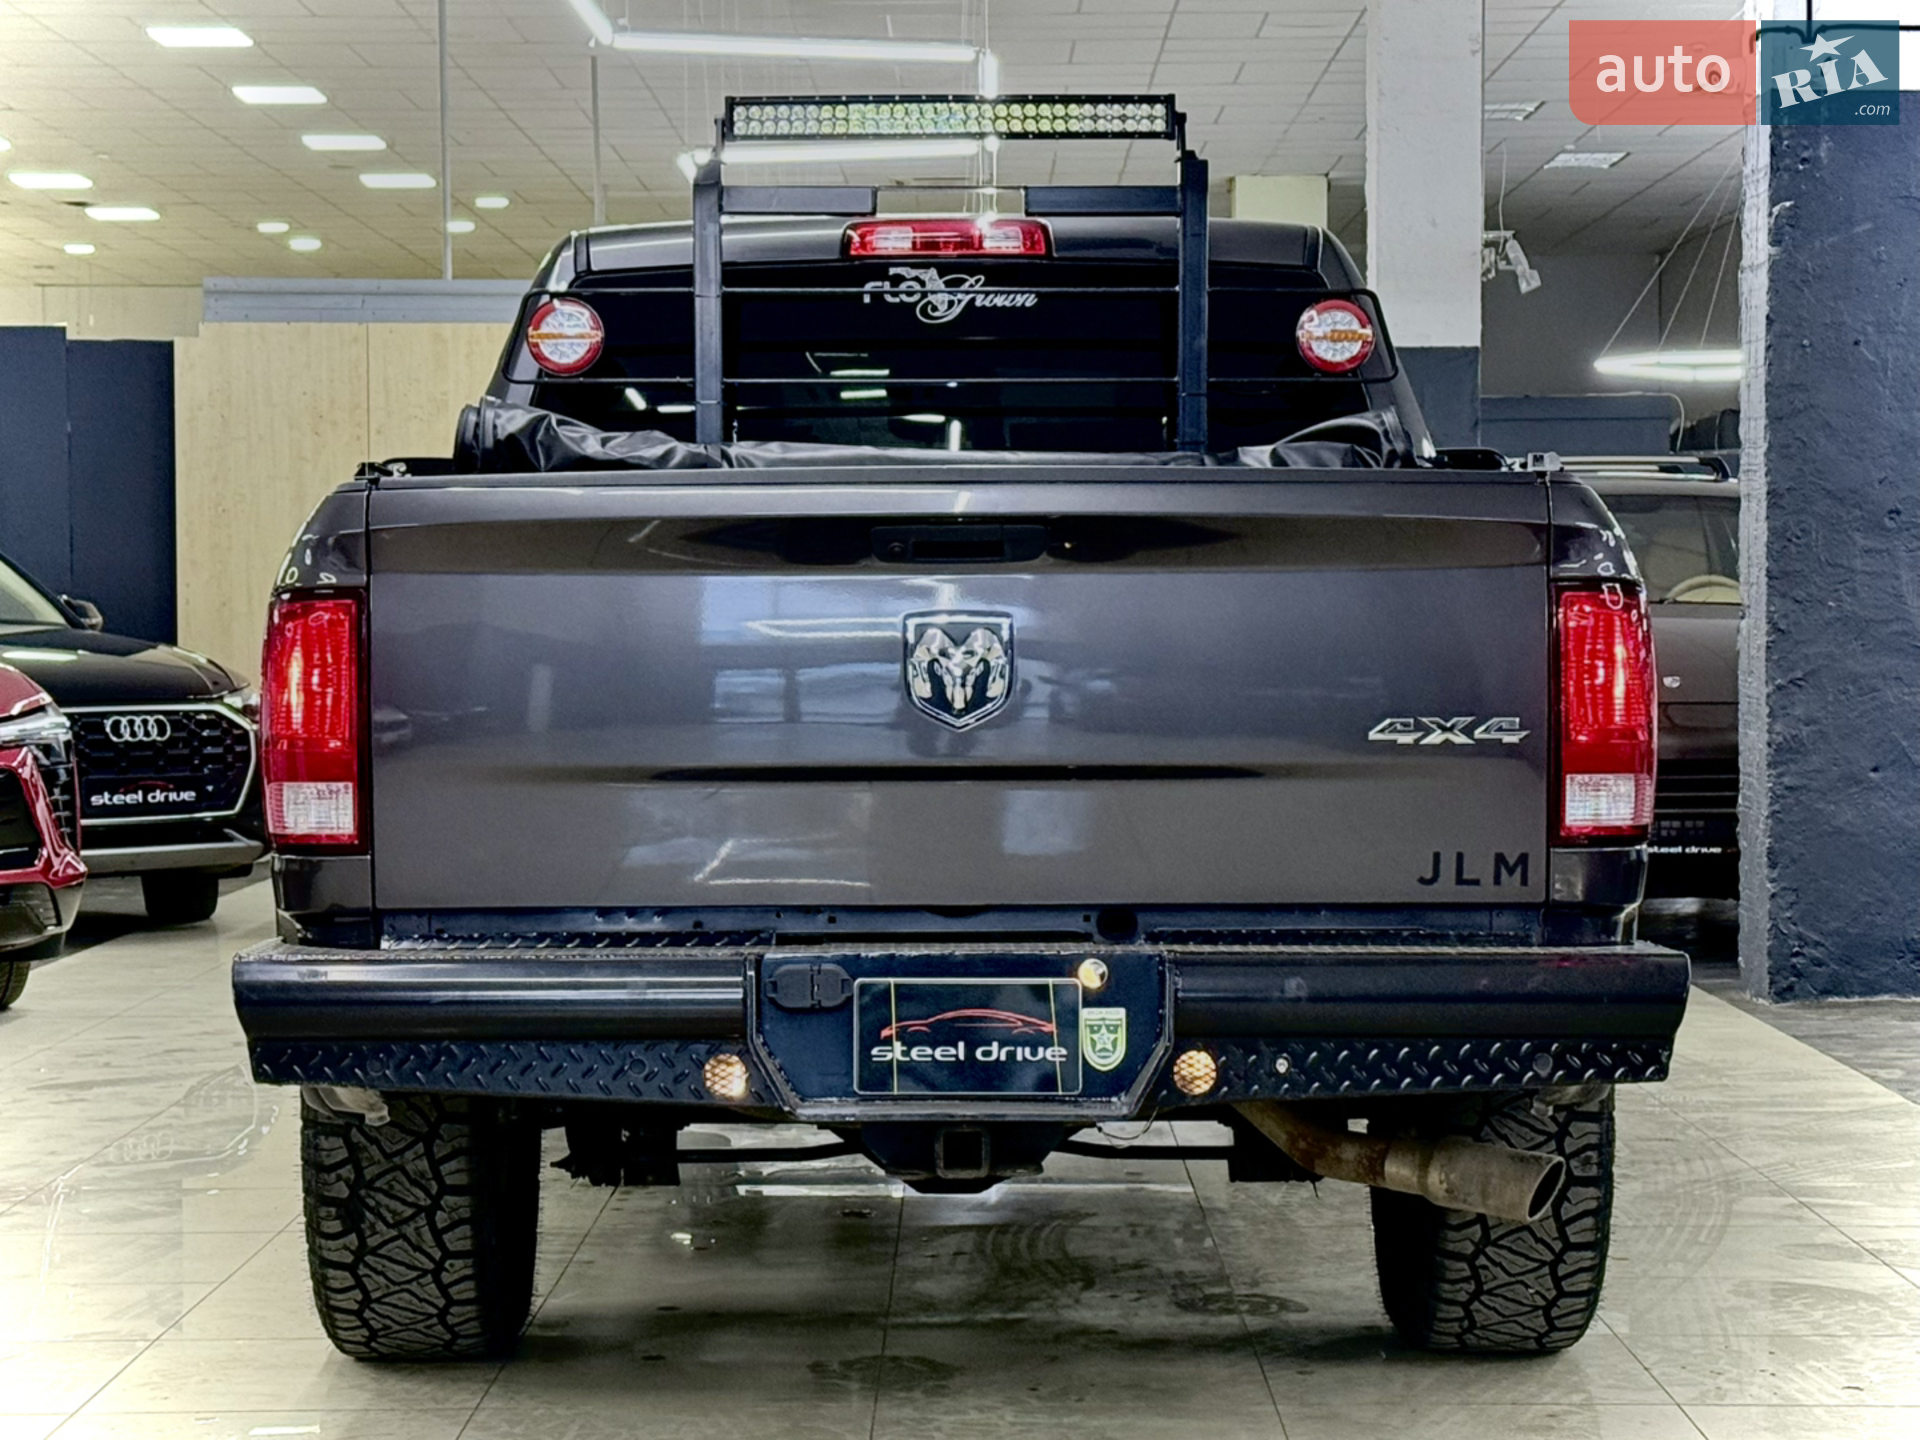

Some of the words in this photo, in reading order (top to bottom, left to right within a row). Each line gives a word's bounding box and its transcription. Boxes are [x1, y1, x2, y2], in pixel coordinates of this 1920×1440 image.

[90, 790, 143, 806] steel
[147, 788, 197, 803] drive
[1646, 845, 1683, 854] steel
[1684, 845, 1722, 854] drive
[1417, 851, 1529, 887] JLM
[870, 1040, 965, 1062] steel
[975, 1040, 1068, 1062] drive
